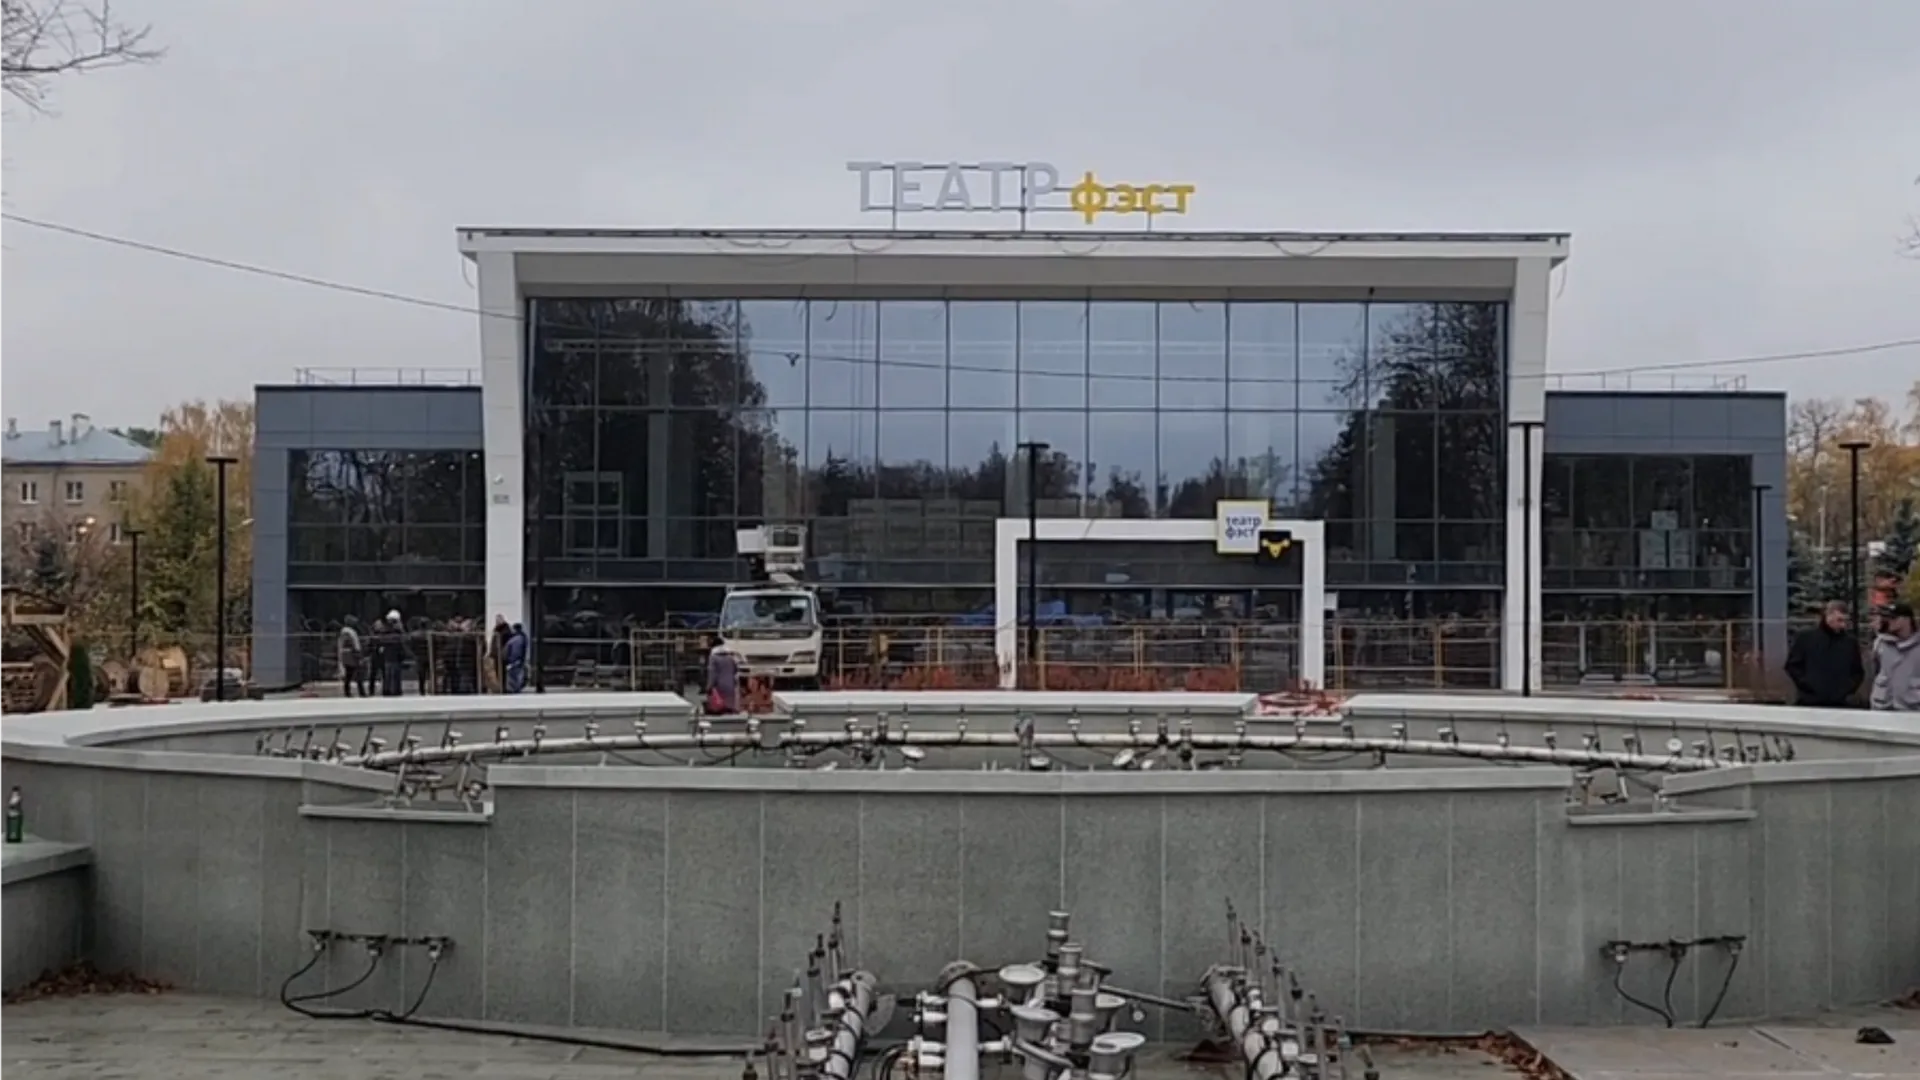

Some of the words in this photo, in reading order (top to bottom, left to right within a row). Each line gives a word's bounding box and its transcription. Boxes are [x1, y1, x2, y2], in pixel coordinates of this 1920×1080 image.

[847, 162, 1058, 212] ТЕАТР
[1071, 171, 1195, 224] фэст
[1225, 516, 1262, 527] театр
